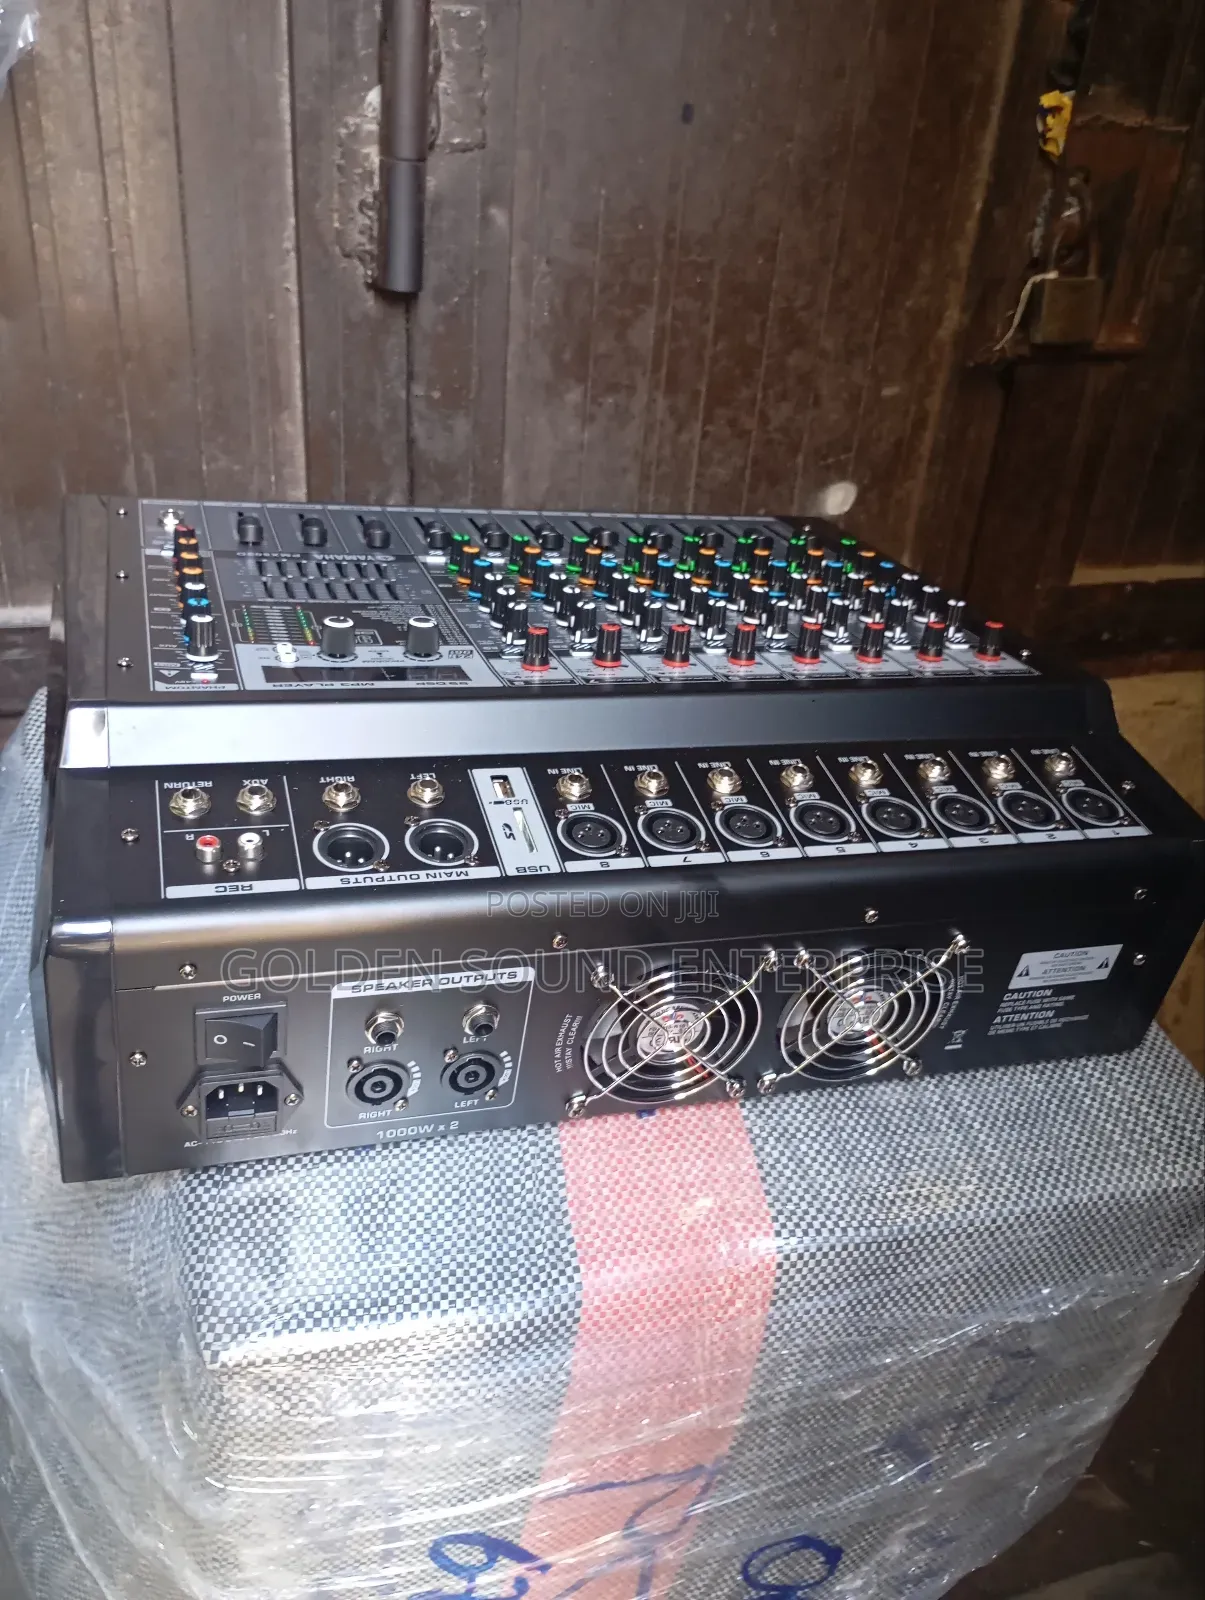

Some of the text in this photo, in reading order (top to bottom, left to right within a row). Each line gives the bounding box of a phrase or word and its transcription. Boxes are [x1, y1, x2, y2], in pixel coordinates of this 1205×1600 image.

[409, 772, 437, 780] LEFT
[560, 767, 583, 775] LINE
[242, 778, 269, 787] AUX
[319, 775, 356, 784] RIGHT
[163, 780, 213, 790] RETURN
[185, 833, 195, 841] R
[262, 829, 270, 837] L
[835, 846, 846, 854] 5
[515, 865, 551, 874] USB
[340, 870, 469, 886] MAIN OUTPUTS
[214, 883, 254, 894] REC
[1053, 950, 1089, 960] CAUTION
[351, 970, 518, 993] SPEAKER OUTPUTS
[222, 992, 262, 1003] POWER
[1003, 989, 1053, 1001] CAUTION
[992, 1010, 1056, 1024] ATTENTION
[554, 1014, 572, 1072] HOT AIR EXHAUST
[363, 1043, 399, 1054] RIGHT
[454, 1098, 480, 1108] LEFT
[358, 1109, 393, 1120] RIGHT
[376, 1123, 435, 1140] 1000W
[449, 1120, 460, 1130] 2
